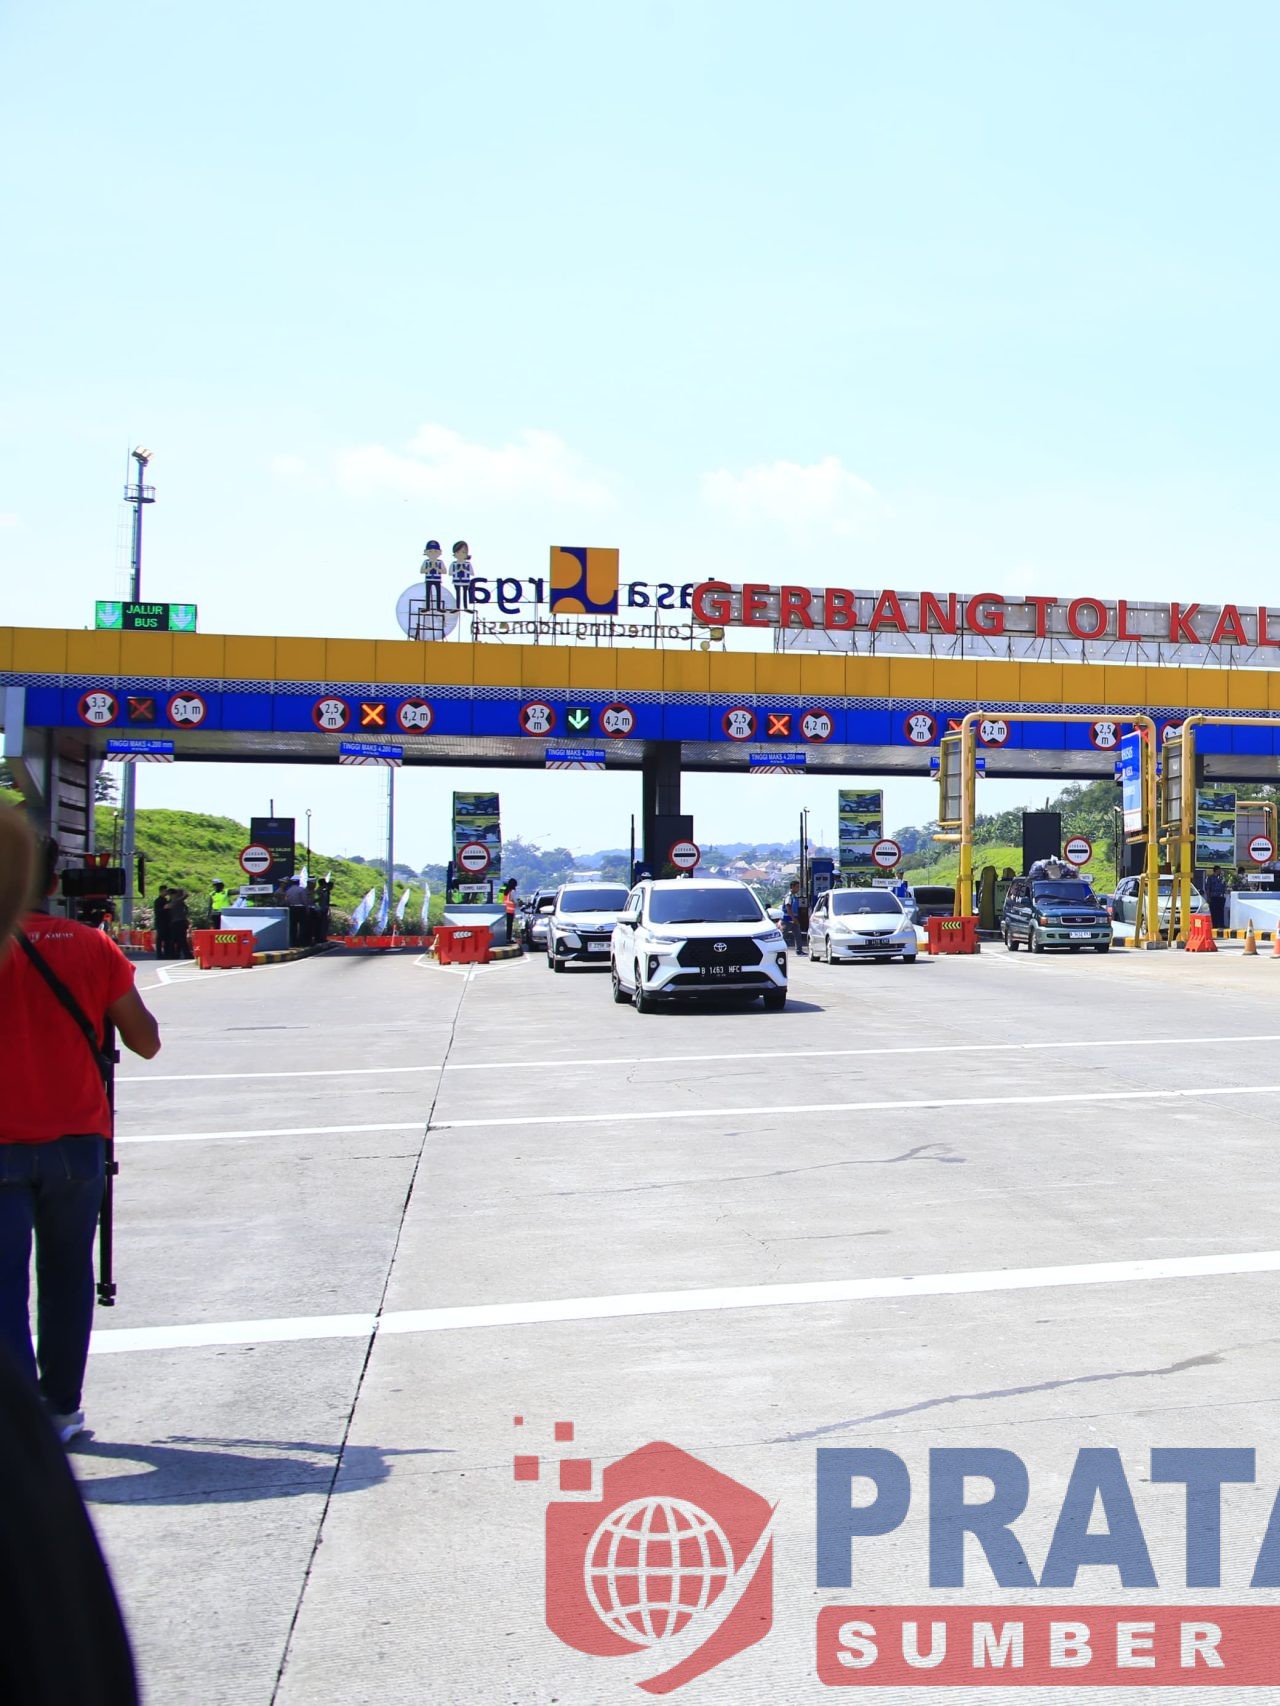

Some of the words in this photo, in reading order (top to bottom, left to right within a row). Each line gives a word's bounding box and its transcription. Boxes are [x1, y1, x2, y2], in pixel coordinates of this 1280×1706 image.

[126, 604, 163, 615] JALUR
[692, 581, 1005, 636] GERBANG
[1025, 596, 1142, 641] TOL
[135, 618, 158, 628] BUS
[91, 697, 106, 709] 3,3
[174, 705, 187, 716] 5,1
[192, 706, 200, 715] m
[325, 703, 339, 715] 2,5
[532, 708, 545, 719] 2,5
[95, 711, 104, 720] m
[403, 711, 417, 723] 4,2
[419, 712, 428, 721] m
[605, 715, 619, 727] 4,2
[622, 717, 630, 726] m
[734, 713, 747, 724] 2,5
[328, 718, 337, 726] m
[533, 721, 542, 730] m
[804, 720, 818, 732] 4,2
[821, 722, 829, 731] m
[915, 717, 927, 727] 2,5
[736, 726, 744, 735] m
[982, 725, 996, 736] 4,2
[998, 727, 1005, 735] m
[1099, 724, 1112, 734] 2,5
[917, 731, 925, 740] m
[1101, 737, 1109, 745] m
